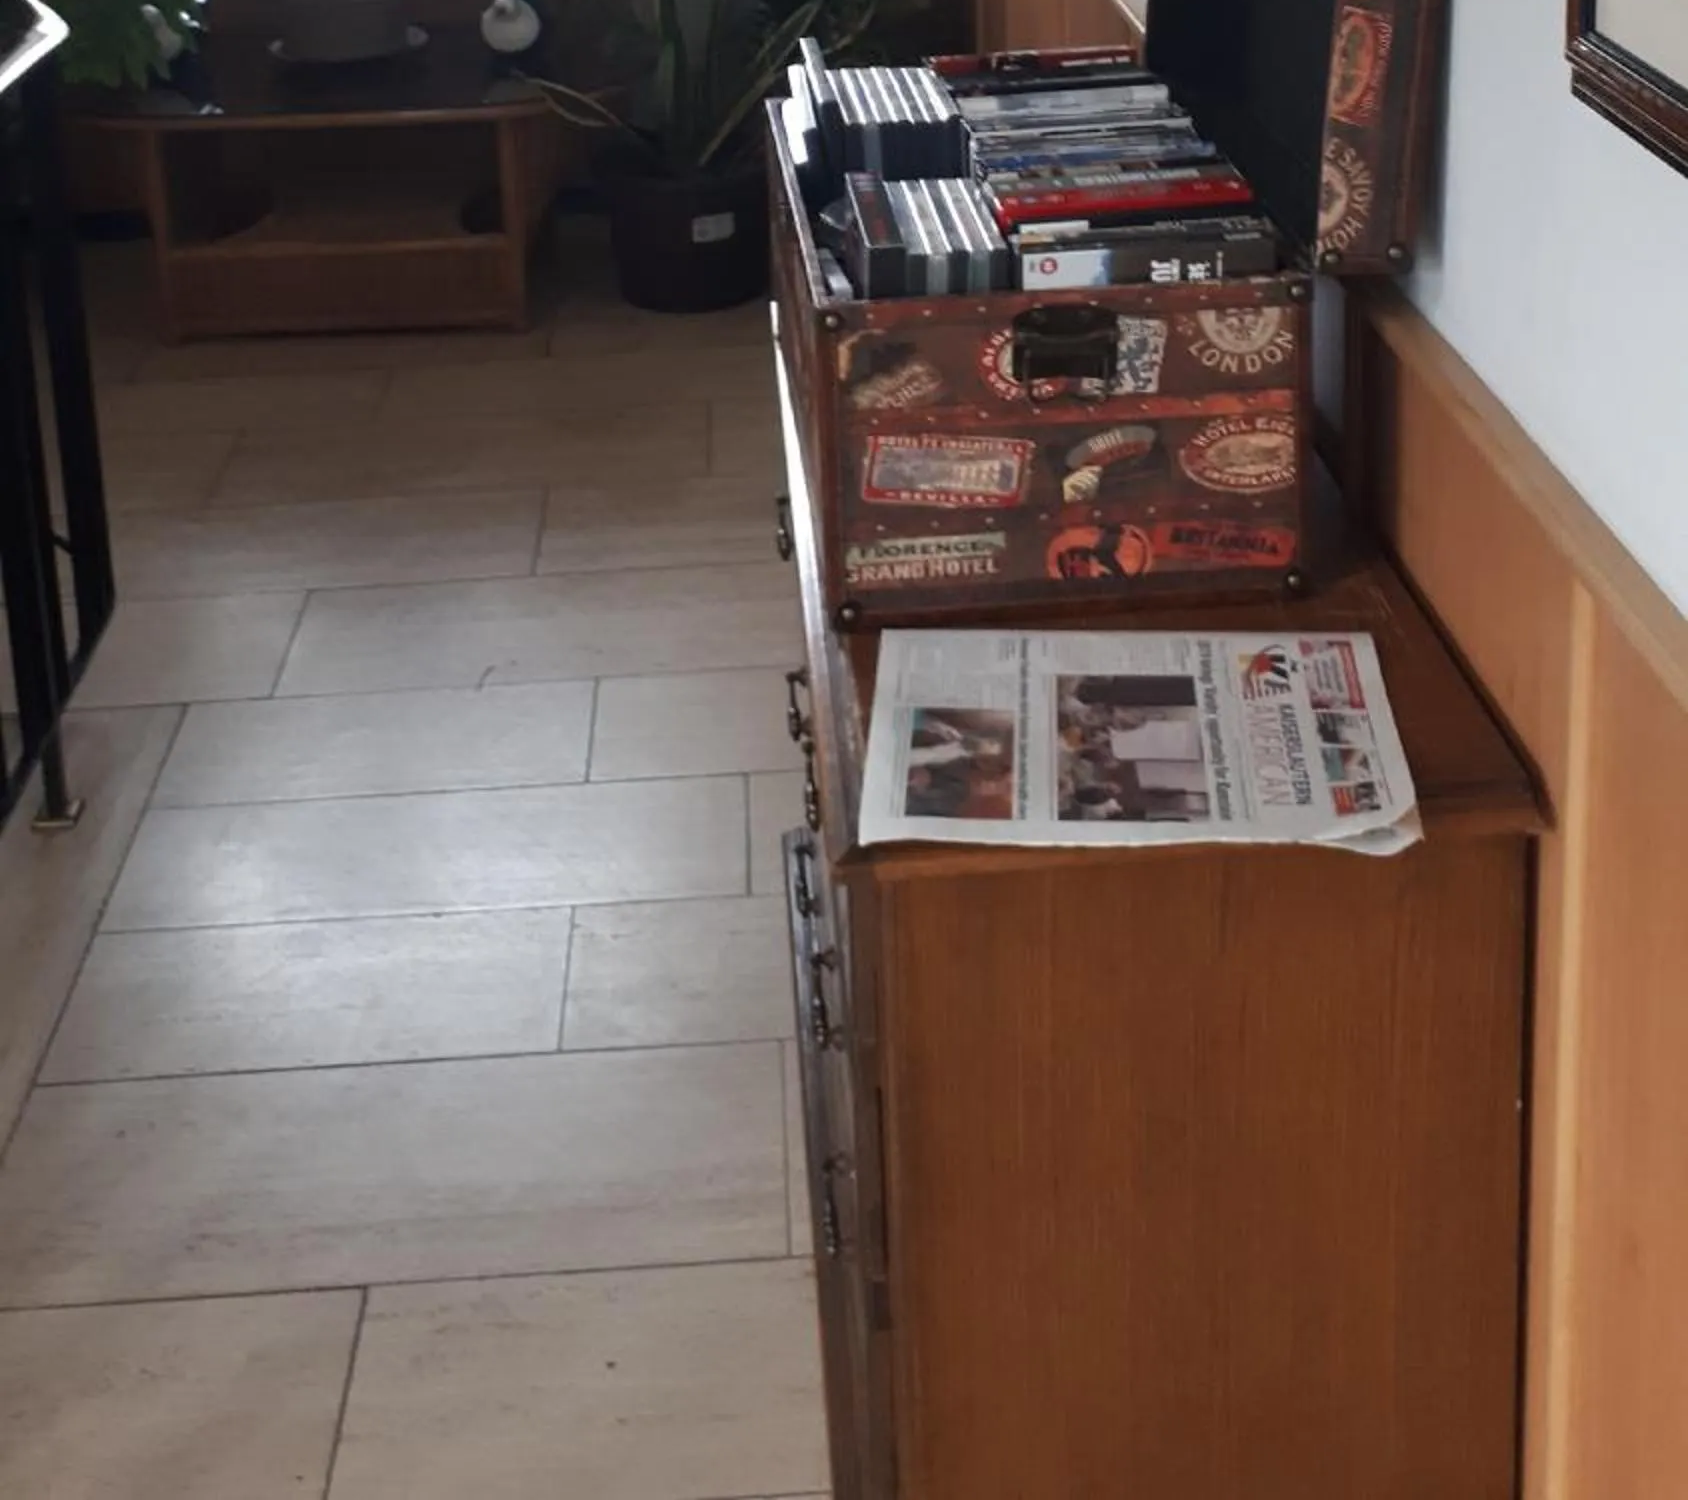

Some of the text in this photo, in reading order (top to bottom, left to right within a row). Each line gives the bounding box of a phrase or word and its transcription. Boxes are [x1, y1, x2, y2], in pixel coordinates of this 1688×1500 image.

[1189, 329, 1294, 374] LONDON
[1192, 417, 1251, 447] HOTEL
[847, 557, 1000, 583] GRAND HOTEL
[1248, 704, 1292, 805] AMERICAN
[1280, 703, 1312, 805] KAISERSLAUTERN
